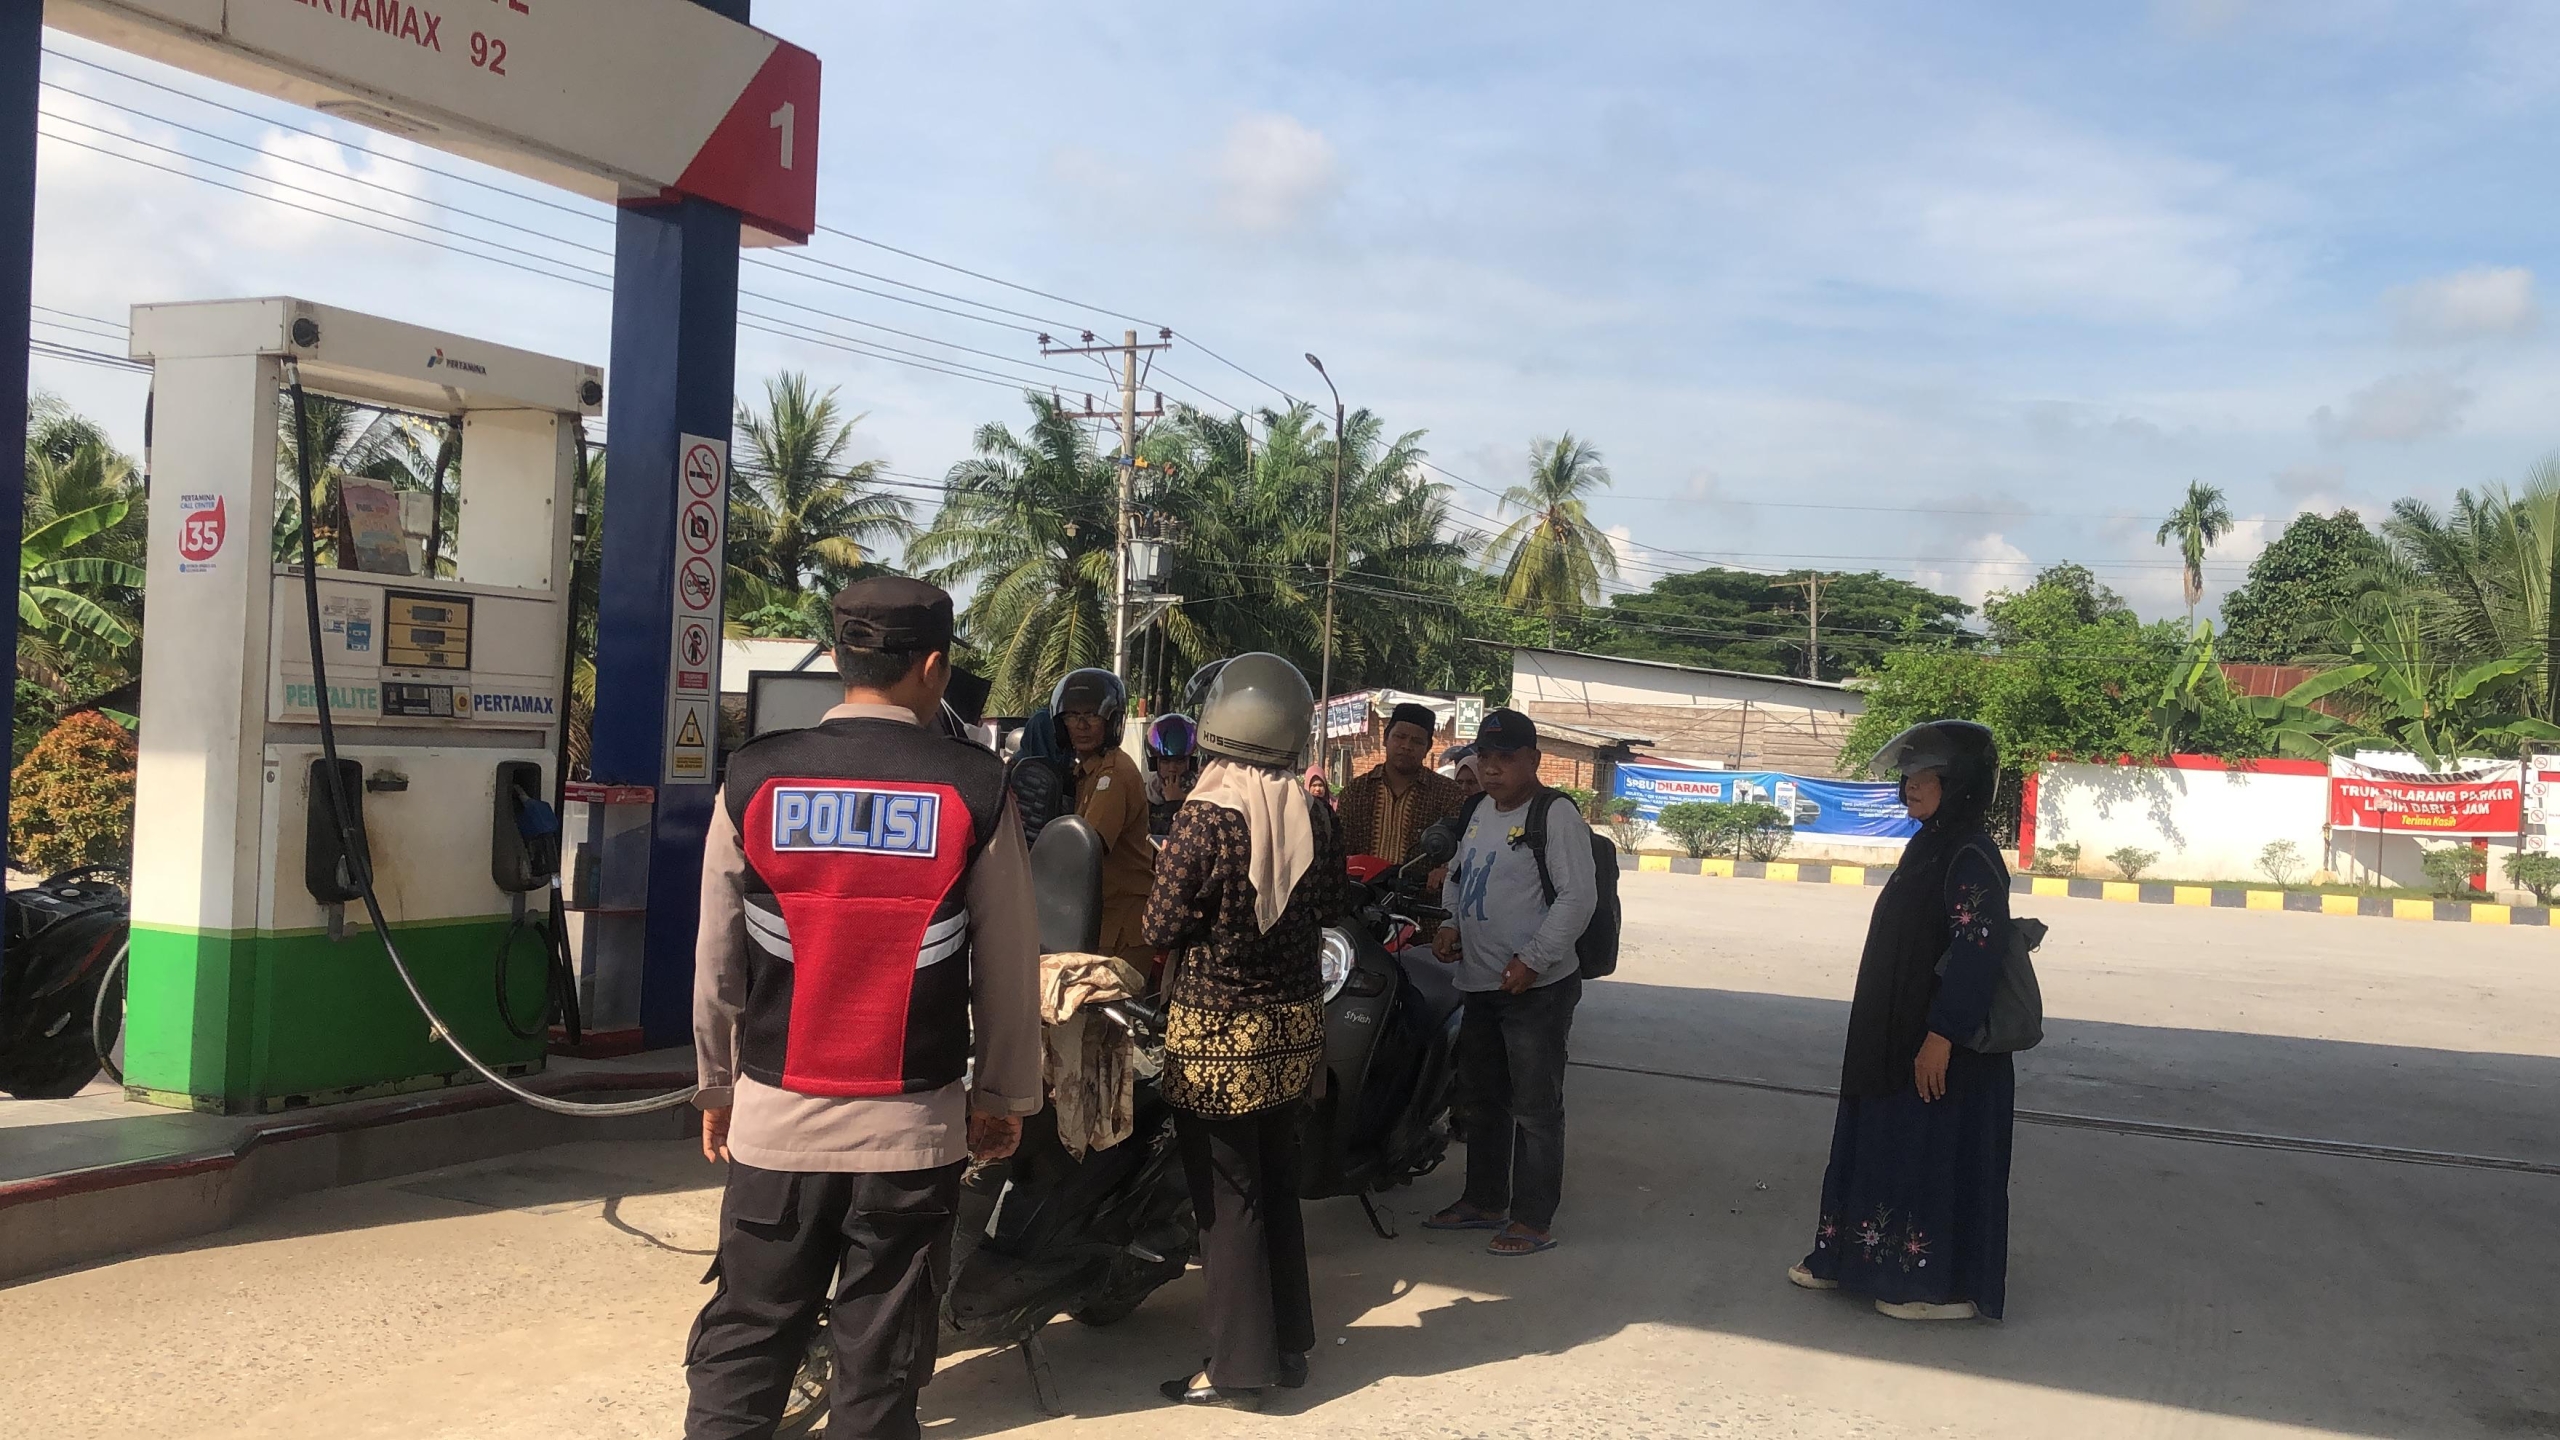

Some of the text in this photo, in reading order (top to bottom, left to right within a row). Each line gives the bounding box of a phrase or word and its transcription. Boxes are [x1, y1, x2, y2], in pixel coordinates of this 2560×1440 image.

[297, 0, 507, 76] TAMAX 92
[769, 101, 795, 171] 1
[180, 521, 219, 552] 135
[286, 684, 378, 710] PERALITE
[473, 694, 554, 714] PERTAMAX
[2369, 767, 2484, 784] PERHATIAN
[1657, 782, 1720, 795] DILARANG
[2340, 785, 2380, 798] TRUK
[2460, 788, 2514, 801] PARKIR
[2364, 800, 2490, 815] LBIH DARI 1 JAM
[778, 792, 933, 849] POLISI
[2401, 814, 2457, 827] Terima Kasih
[1344, 1010, 1372, 1025] Stylish
